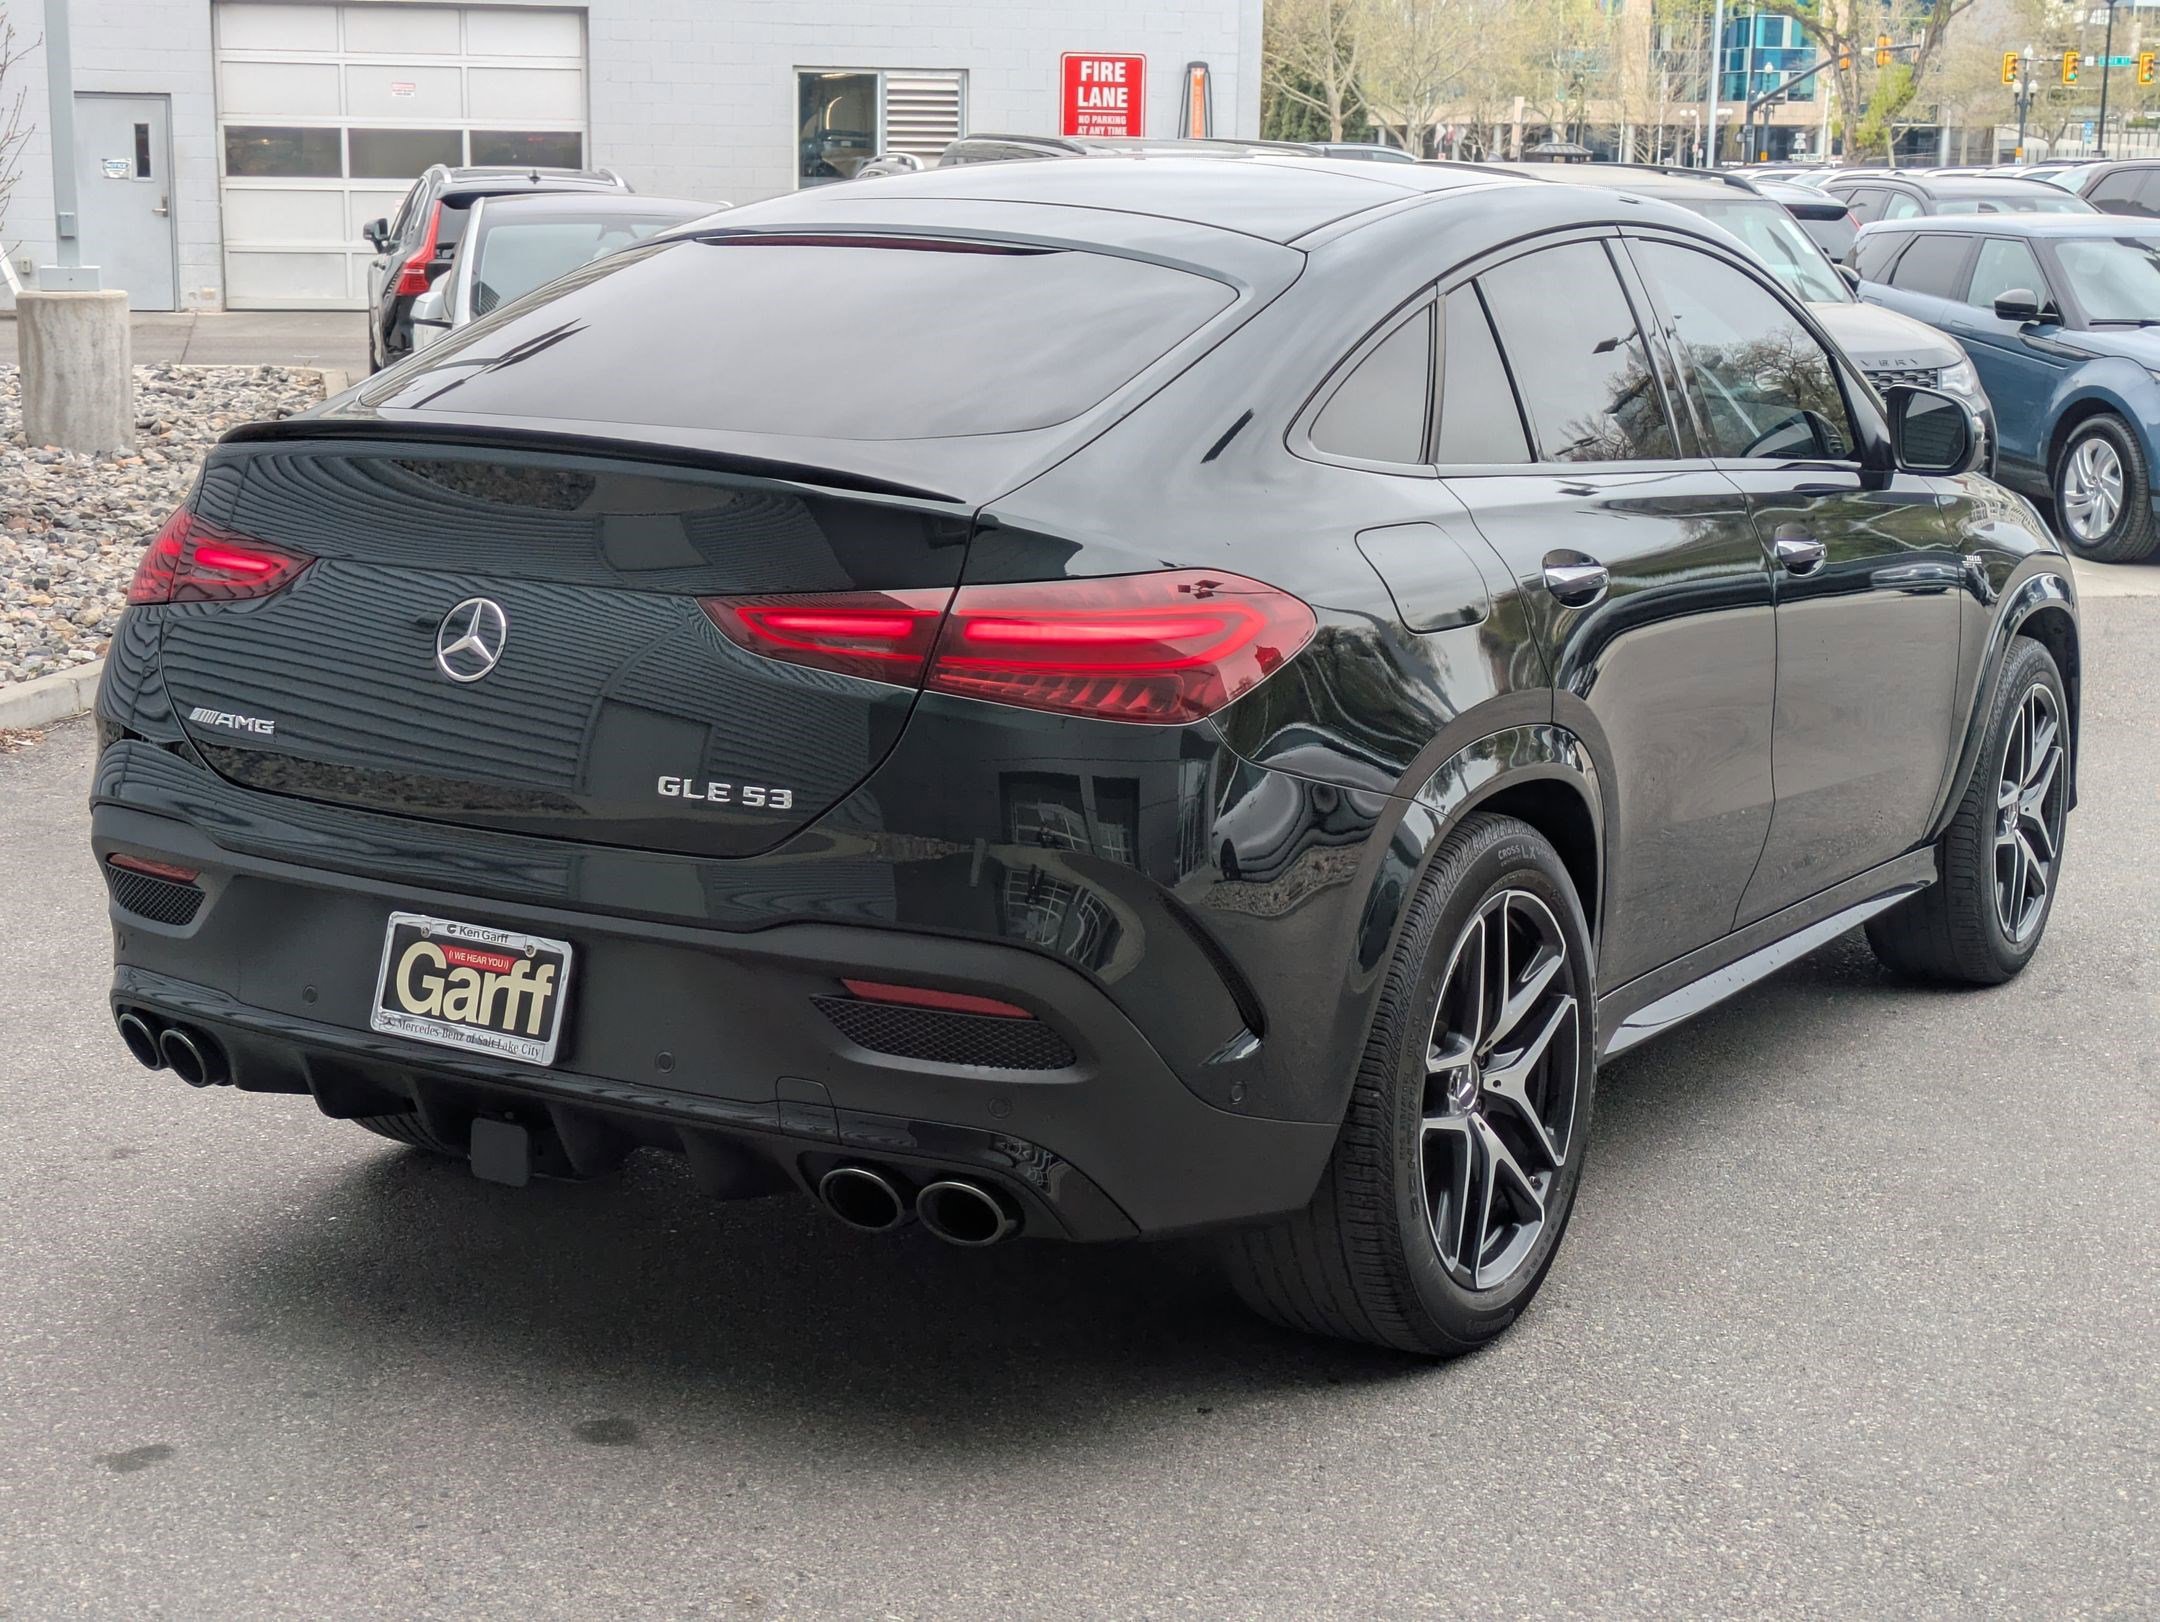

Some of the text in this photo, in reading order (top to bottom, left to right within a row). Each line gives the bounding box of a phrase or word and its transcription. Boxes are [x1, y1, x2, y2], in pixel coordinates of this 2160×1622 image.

[1080, 60, 1127, 83] FIRE
[1077, 85, 1129, 108] LANE
[1077, 125, 1128, 136] AT ANY TIME
[1078, 114, 1127, 125] NO PARKING
[657, 775, 793, 810] GLE 53
[458, 925, 509, 944] Ken Garff
[454, 951, 504, 968] WE HEAR YOU
[396, 940, 556, 1036] Garff
[398, 1018, 465, 1042] Mercedes-Benz
[479, 1034, 496, 1049] Salt
[497, 1039, 519, 1055] Lake
[521, 1042, 541, 1058] City
